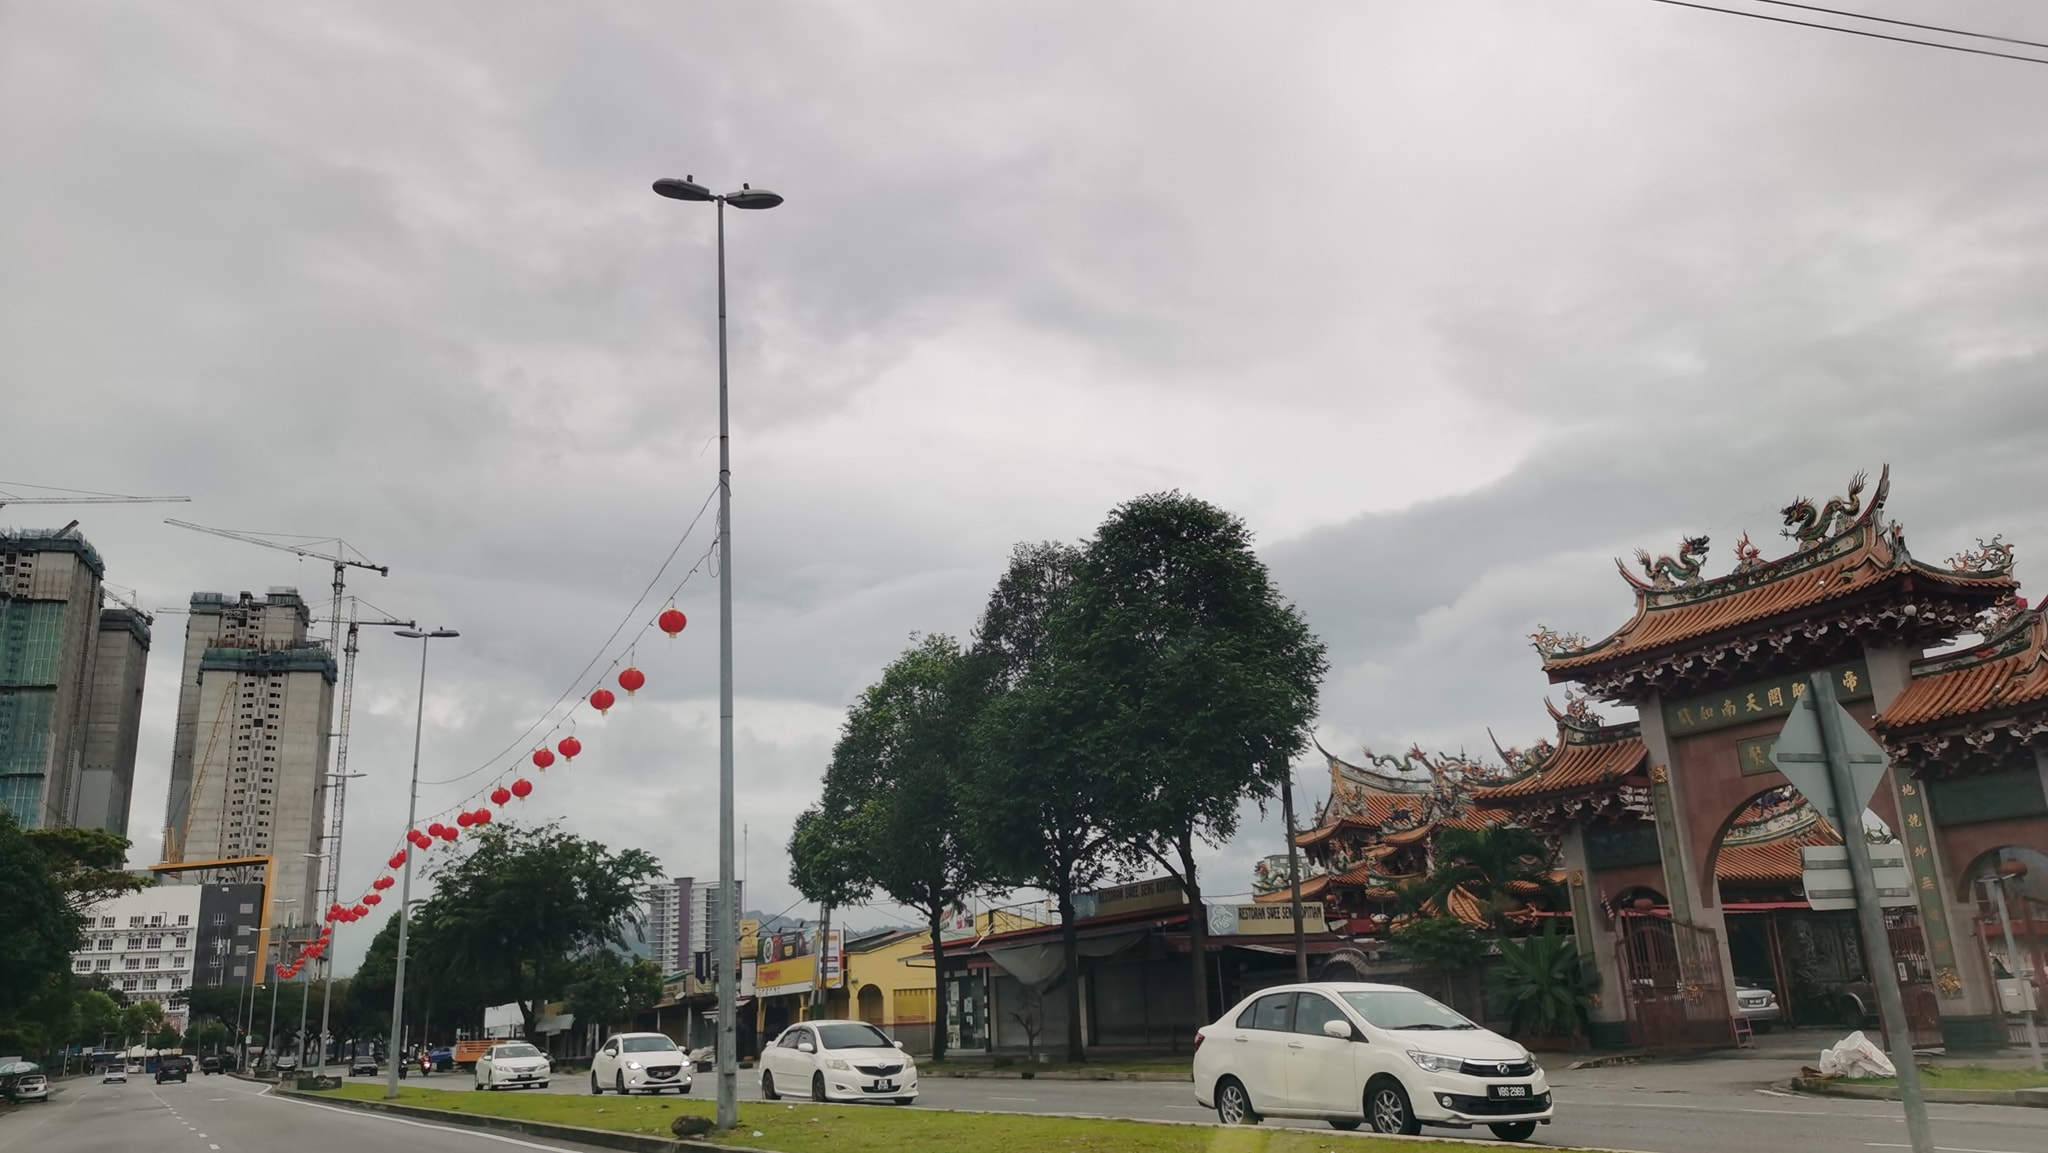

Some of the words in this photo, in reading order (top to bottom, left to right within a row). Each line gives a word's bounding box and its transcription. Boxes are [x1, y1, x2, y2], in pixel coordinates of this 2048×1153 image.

[1238, 906, 1266, 920] RESTORAN
[1266, 906, 1281, 920] SWEE
[1282, 906, 1293, 920] SEN
[1497, 1086, 1509, 1097] VBS
